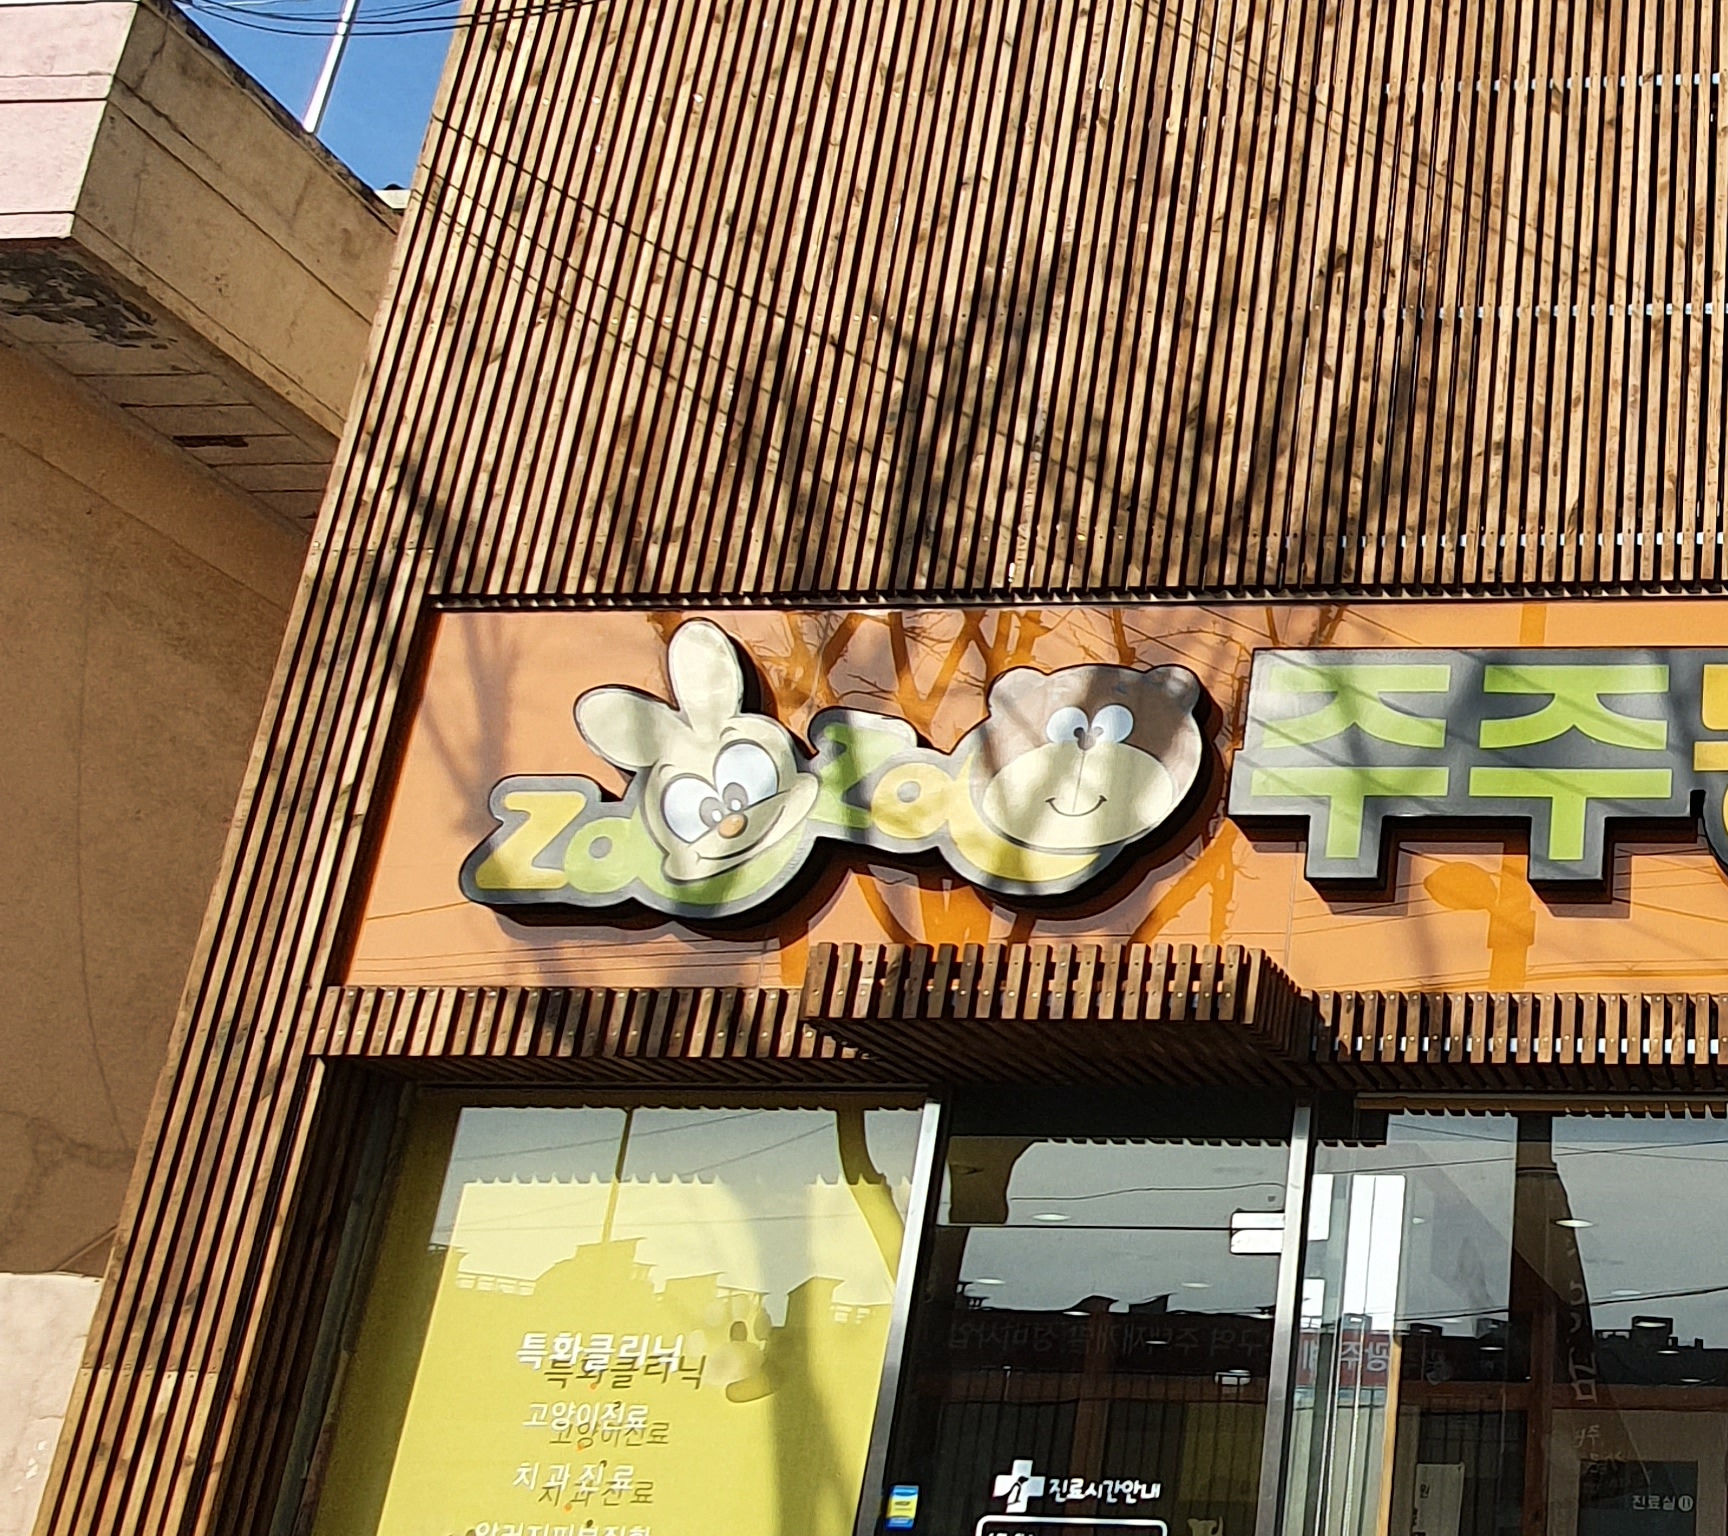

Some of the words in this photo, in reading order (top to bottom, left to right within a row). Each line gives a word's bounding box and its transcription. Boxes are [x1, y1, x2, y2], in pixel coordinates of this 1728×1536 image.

[516, 1332, 684, 1372] 특화클리닉
[523, 1401, 648, 1433] 고양이진료
[1049, 1478, 1161, 1504] 진료시간안내
